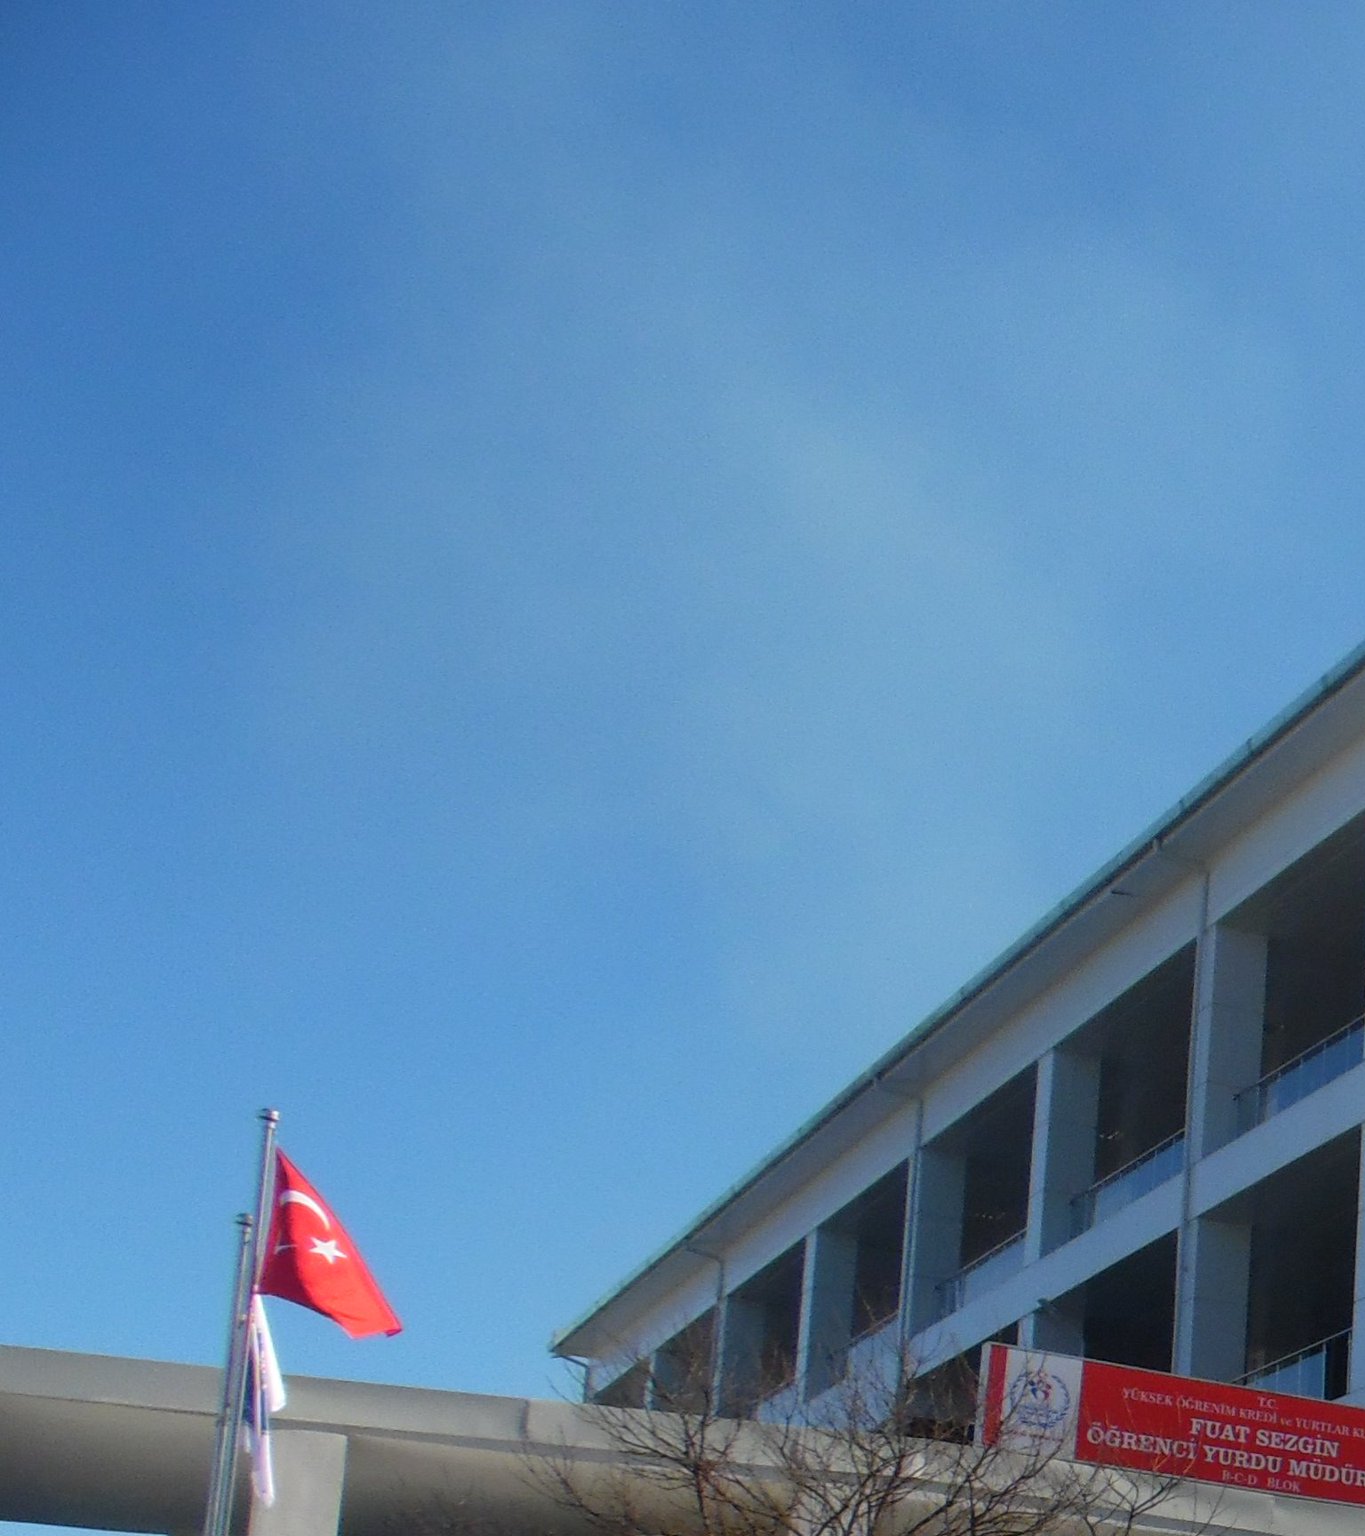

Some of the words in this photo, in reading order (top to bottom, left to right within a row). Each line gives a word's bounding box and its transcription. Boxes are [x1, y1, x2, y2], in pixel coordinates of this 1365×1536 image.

[1122, 1387, 1173, 1407] YÜKSEK
[1177, 1394, 1236, 1418] ÖĞRENİM
[1239, 1406, 1278, 1424] KREDİ
[1295, 1417, 1350, 1437] YURTLAR
[1086, 1420, 1198, 1460] ÖĞRENCİ
[1202, 1444, 1283, 1474] YURDU
[1190, 1417, 1251, 1444] FUAT
[1255, 1429, 1340, 1459] SEZGİN
[1267, 1476, 1301, 1493] BLOK
